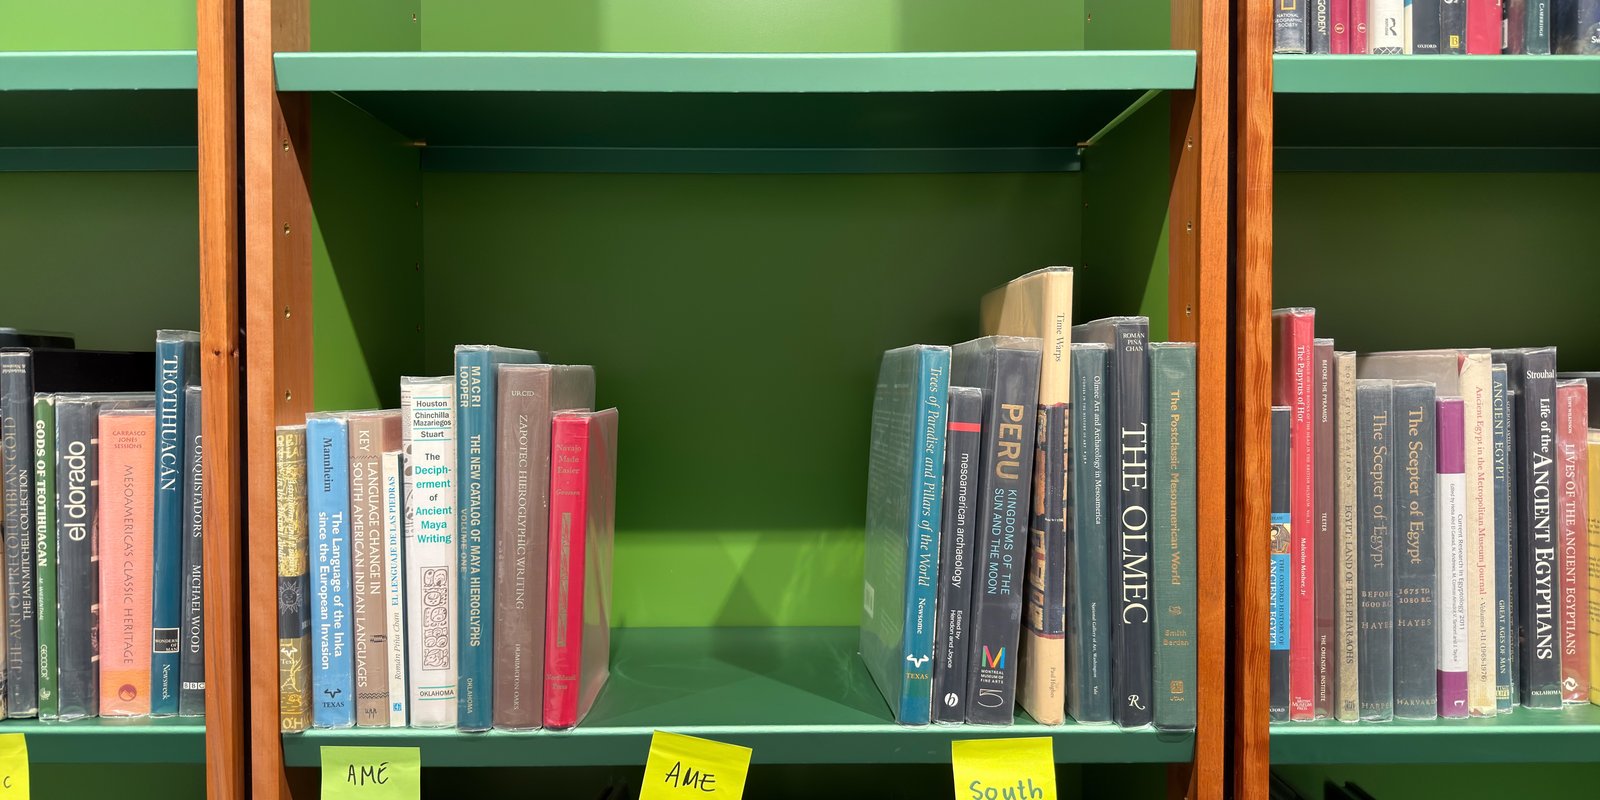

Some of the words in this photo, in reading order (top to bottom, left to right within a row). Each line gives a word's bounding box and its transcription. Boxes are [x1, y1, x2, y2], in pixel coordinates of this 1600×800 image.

[1056, 313, 1065, 335] Time
[1053, 337, 1065, 362] Warps
[460, 366, 469, 408] LOOPER
[471, 366, 481, 408] MACRI
[929, 367, 943, 392] Trees
[1093, 376, 1102, 399] Olmec
[1296, 363, 1305, 395] Papyrus
[1527, 369, 1555, 379] Strouhal
[925, 396, 941, 409] of
[1170, 390, 1180, 411] The
[1298, 397, 1305, 405] of
[1494, 381, 1504, 437] ANCIENT
[1540, 398, 1551, 418] Life
[36, 420, 46, 457] GODS
[161, 356, 179, 492] TEOTIHUACÁN
[414, 419, 452, 428] Mazariegos
[926, 410, 940, 454] Paradise
[1374, 411, 1388, 441] The
[1409, 407, 1423, 436] The
[1541, 421, 1551, 433] of
[360, 430, 370, 452] KEY
[471, 435, 481, 454] THE
[519, 415, 528, 468] ZAPOTEC
[996, 403, 1025, 480] PERU
[1092, 427, 1102, 470] Archaeology
[1122, 422, 1148, 492] THE
[1170, 414, 1180, 470] Postclassic
[1542, 435, 1552, 453] the
[37, 460, 47, 477] OF
[323, 438, 334, 493] Mannheim
[415, 466, 452, 476] Deciph-
[471, 457, 481, 480] NEW
[924, 457, 936, 478] and
[1371, 446, 1388, 501] Scepter
[1407, 441, 1423, 496] Scepter
[1495, 442, 1505, 482] EGYPT
[1565, 444, 1576, 478] LIVES
[64, 441, 86, 519] dorado
[192, 436, 203, 538] CONQUISTADORS
[353, 462, 365, 502] SOUTH
[368, 462, 379, 526] LANGUAGE
[416, 480, 451, 488] erment
[958, 453, 970, 526] mesoamerican
[1566, 481, 1576, 497] OF
[20, 469, 30, 530] COLLECTION
[124, 465, 134, 557] MESOAMERICA'S
[416, 507, 452, 516] Ancient
[471, 483, 481, 526] CATALOG
[517, 471, 527, 555] HIEROGLYPHIC
[922, 482, 936, 517] Pillars
[993, 488, 1004, 511] SUN
[1094, 480, 1103, 525] Mesoamerica
[1170, 473, 1180, 549] Mesoamerican
[1374, 505, 1388, 521] of
[1409, 501, 1423, 516] of
[1533, 452, 1553, 543] ANCIENT
[1565, 501, 1576, 526] THE
[37, 480, 48, 567] TEOTIHUACAN
[64, 524, 86, 541] el
[319, 512, 329, 540] since
[333, 511, 342, 535] The
[354, 505, 365, 567] AMERICAN
[421, 521, 447, 531] Maya
[471, 529, 481, 542] OF
[918, 520, 933, 533] of
[992, 513, 1003, 536] AND
[1004, 489, 1017, 550] KINGDOMS
[1345, 505, 1353, 539] EGYPT:
[21, 531, 31, 579] MITCHELL
[320, 544, 329, 563] the
[370, 529, 380, 578] CHANGE
[417, 534, 452, 545] Writing
[920, 534, 932, 551] the
[990, 539, 1001, 559] THE
[1371, 527, 1388, 569] Egypt
[1407, 521, 1423, 564] Egypt
[331, 538, 344, 592] Language
[471, 546, 481, 574] MAYA
[918, 553, 931, 587] World
[952, 528, 966, 588] archaeology
[1002, 554, 1013, 570] OF
[1122, 505, 1148, 625] OLMEC
[1171, 551, 1181, 585] World
[1566, 530, 1576, 584] ANCIENT
[22, 581, 32, 599] JAN
[124, 561, 134, 604] CLASSIC
[192, 565, 202, 614] MICHAEL
[318, 566, 330, 620] European
[355, 572, 365, 614] INDIAN
[370, 582, 381, 595] IN
[516, 557, 526, 609] WRITING
[988, 562, 1000, 595] MOON
[1001, 573, 1012, 595] THE
[1346, 572, 1353, 585] OF
[23, 601, 32, 619] THE
[334, 596, 344, 607] of
[471, 577, 481, 647] HIEROGLYPHS
[917, 598, 926, 635] Newsome
[1536, 547, 1555, 660] EGYPTIANS
[124, 608, 134, 664] HERITAGE
[191, 617, 201, 653] WOOD
[335, 610, 344, 629] the
[1398, 619, 1432, 627] HAYES
[1566, 587, 1576, 655] EGYPTIANS
[322, 624, 332, 670] Invasion
[335, 633, 345, 658] Inka
[357, 617, 368, 688] LANGUAGES
[1346, 610, 1354, 665] PHARAOHS
[163, 665, 171, 700] Newsweek
[1128, 695, 1146, 710] R
[665, 761, 716, 792] AME
[969, 778, 1043, 800] South
